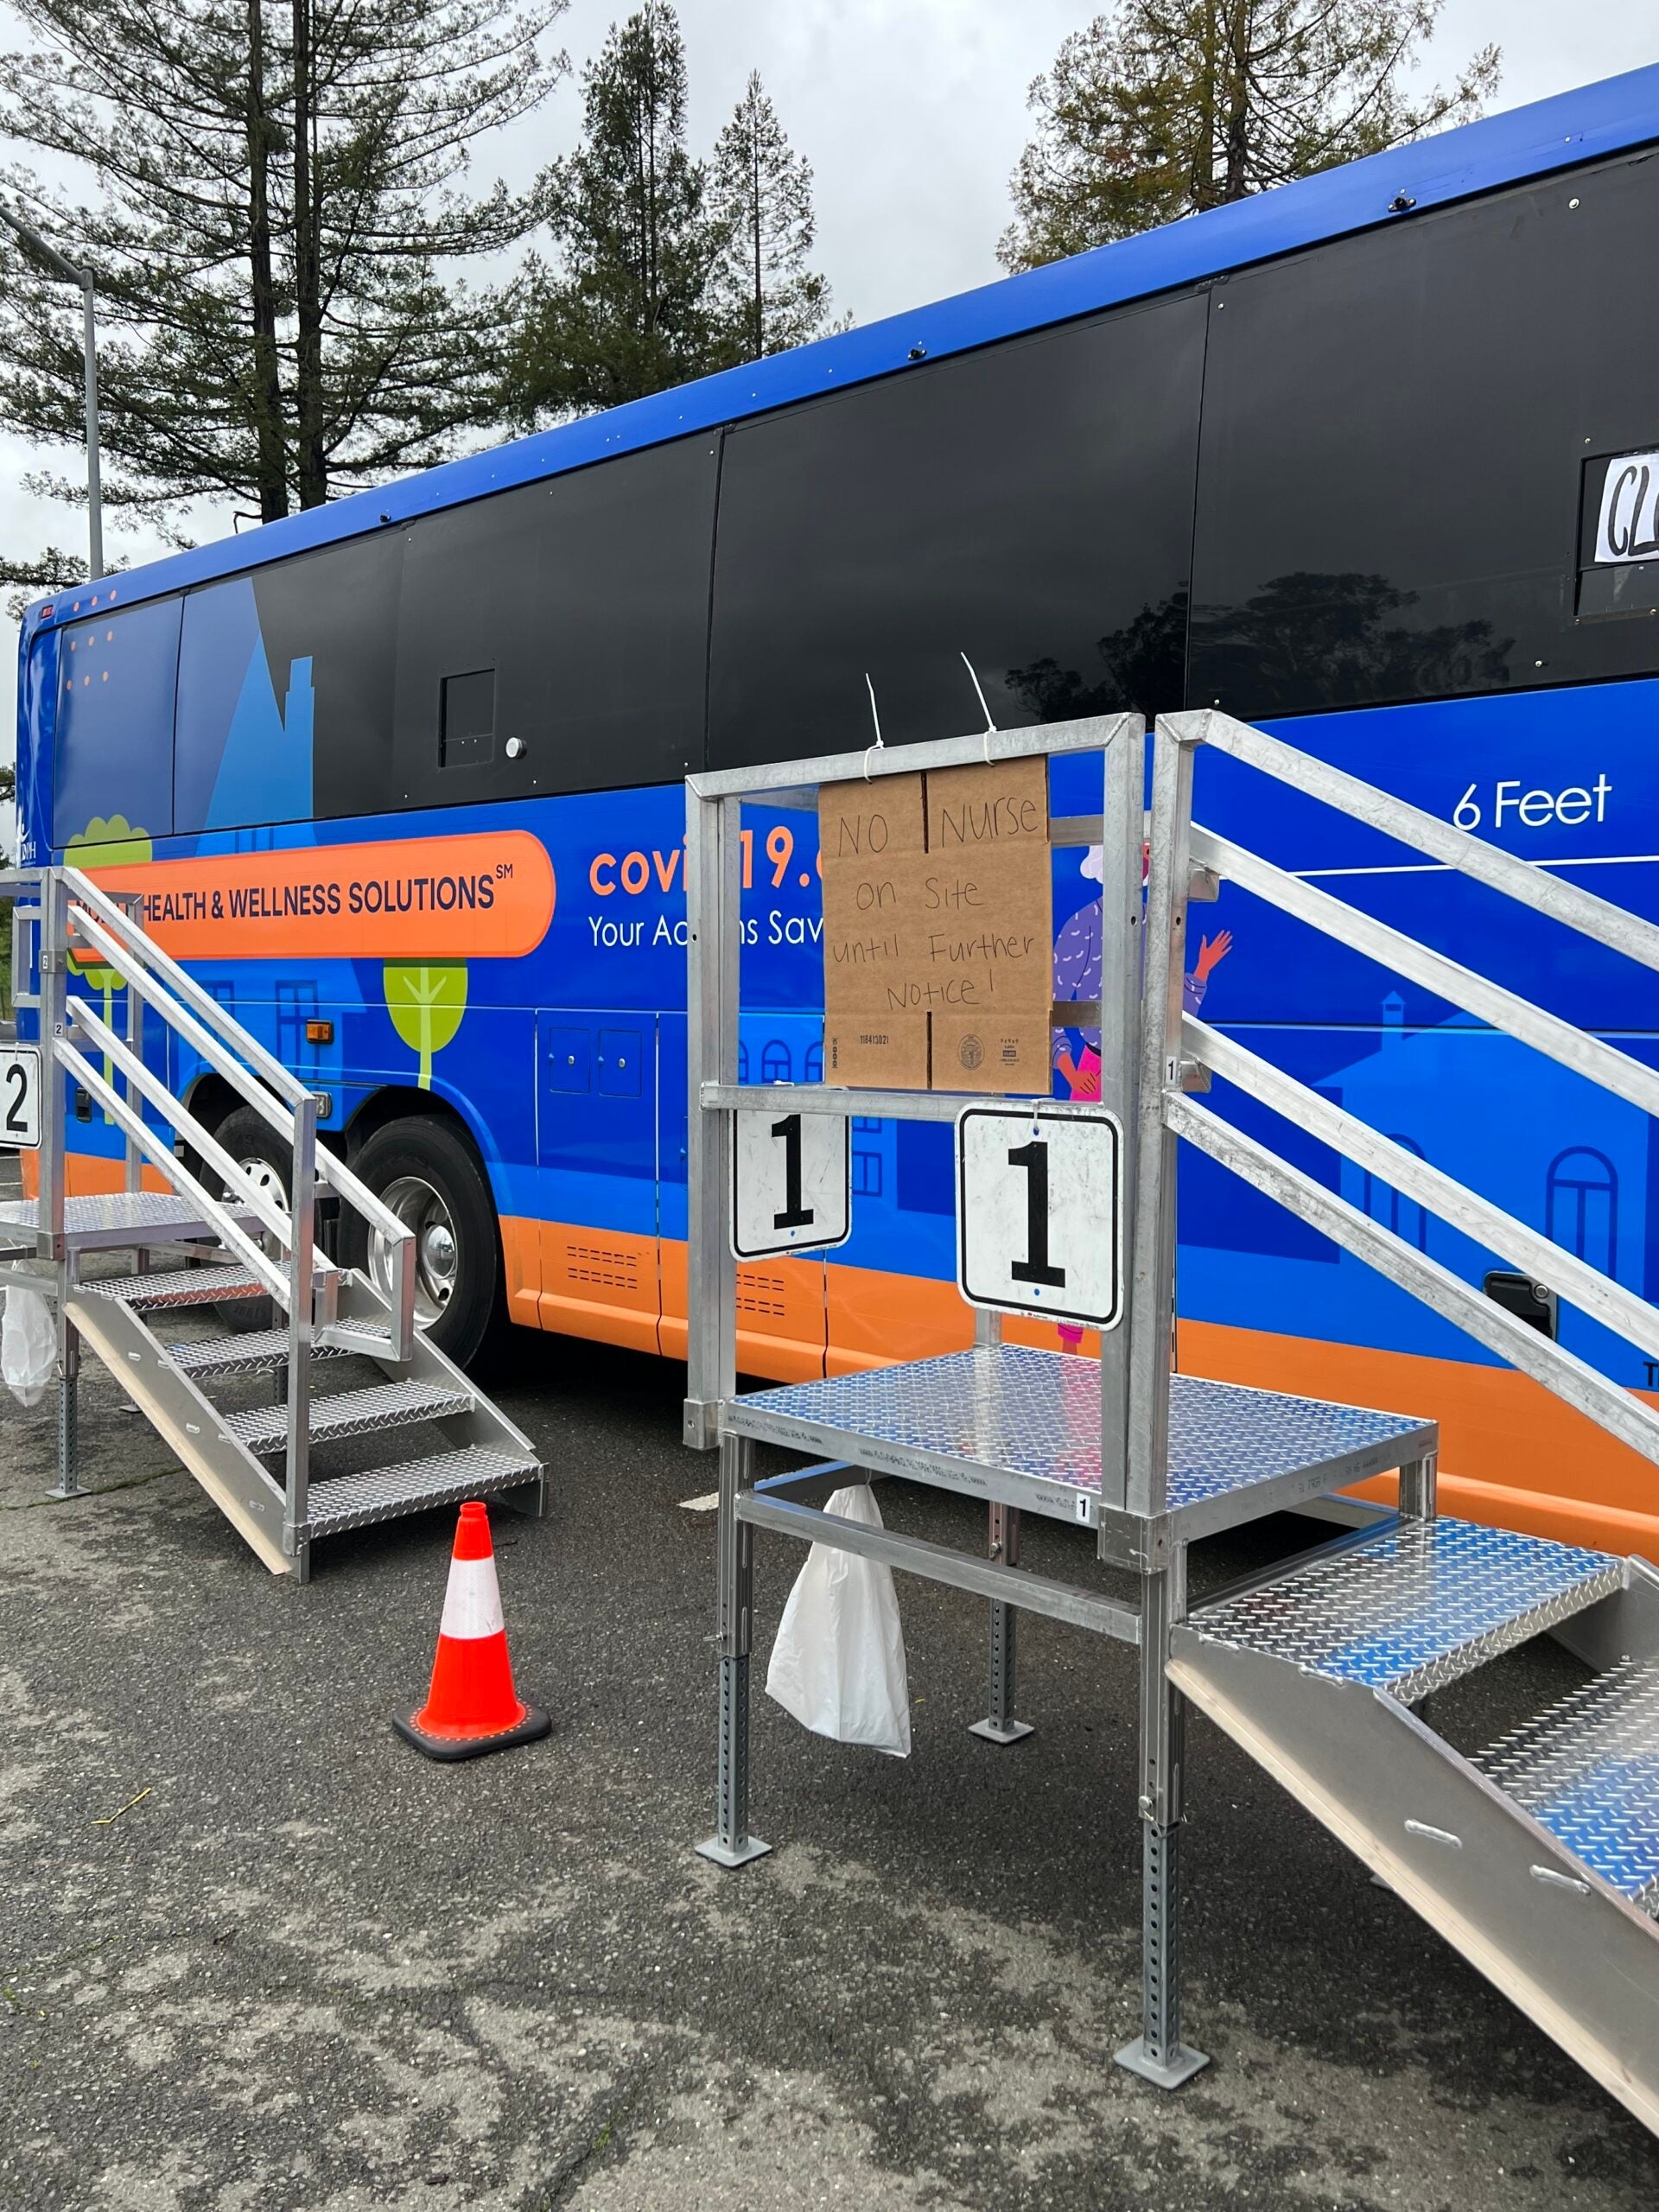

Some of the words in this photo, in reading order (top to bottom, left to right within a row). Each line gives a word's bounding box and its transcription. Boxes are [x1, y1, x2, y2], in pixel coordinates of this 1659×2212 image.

[1608, 466, 1659, 556] CL
[1452, 783, 1481, 830] 6
[1496, 774, 1612, 828] Feet
[838, 814, 888, 856] NO
[942, 797, 1038, 848] Nurse
[211, 890, 225, 919] &
[229, 883, 341, 918] WELLNESS
[348, 874, 495, 913] SOLUTIONS
[925, 877, 984, 910] Site
[588, 916, 645, 946] Your
[768, 910, 823, 944] Sav
[833, 933, 899, 963] until
[928, 933, 1035, 962] Further
[55, 1024, 62, 1034] 2
[1167, 1060, 1174, 1080] 1
[6, 1063, 28, 1133] 2
[772, 1114, 814, 1230] 1
[1007, 1141, 1065, 1288] 1
[1643, 1361, 1659, 1388] T
[1079, 1498, 1087, 1517] 1
